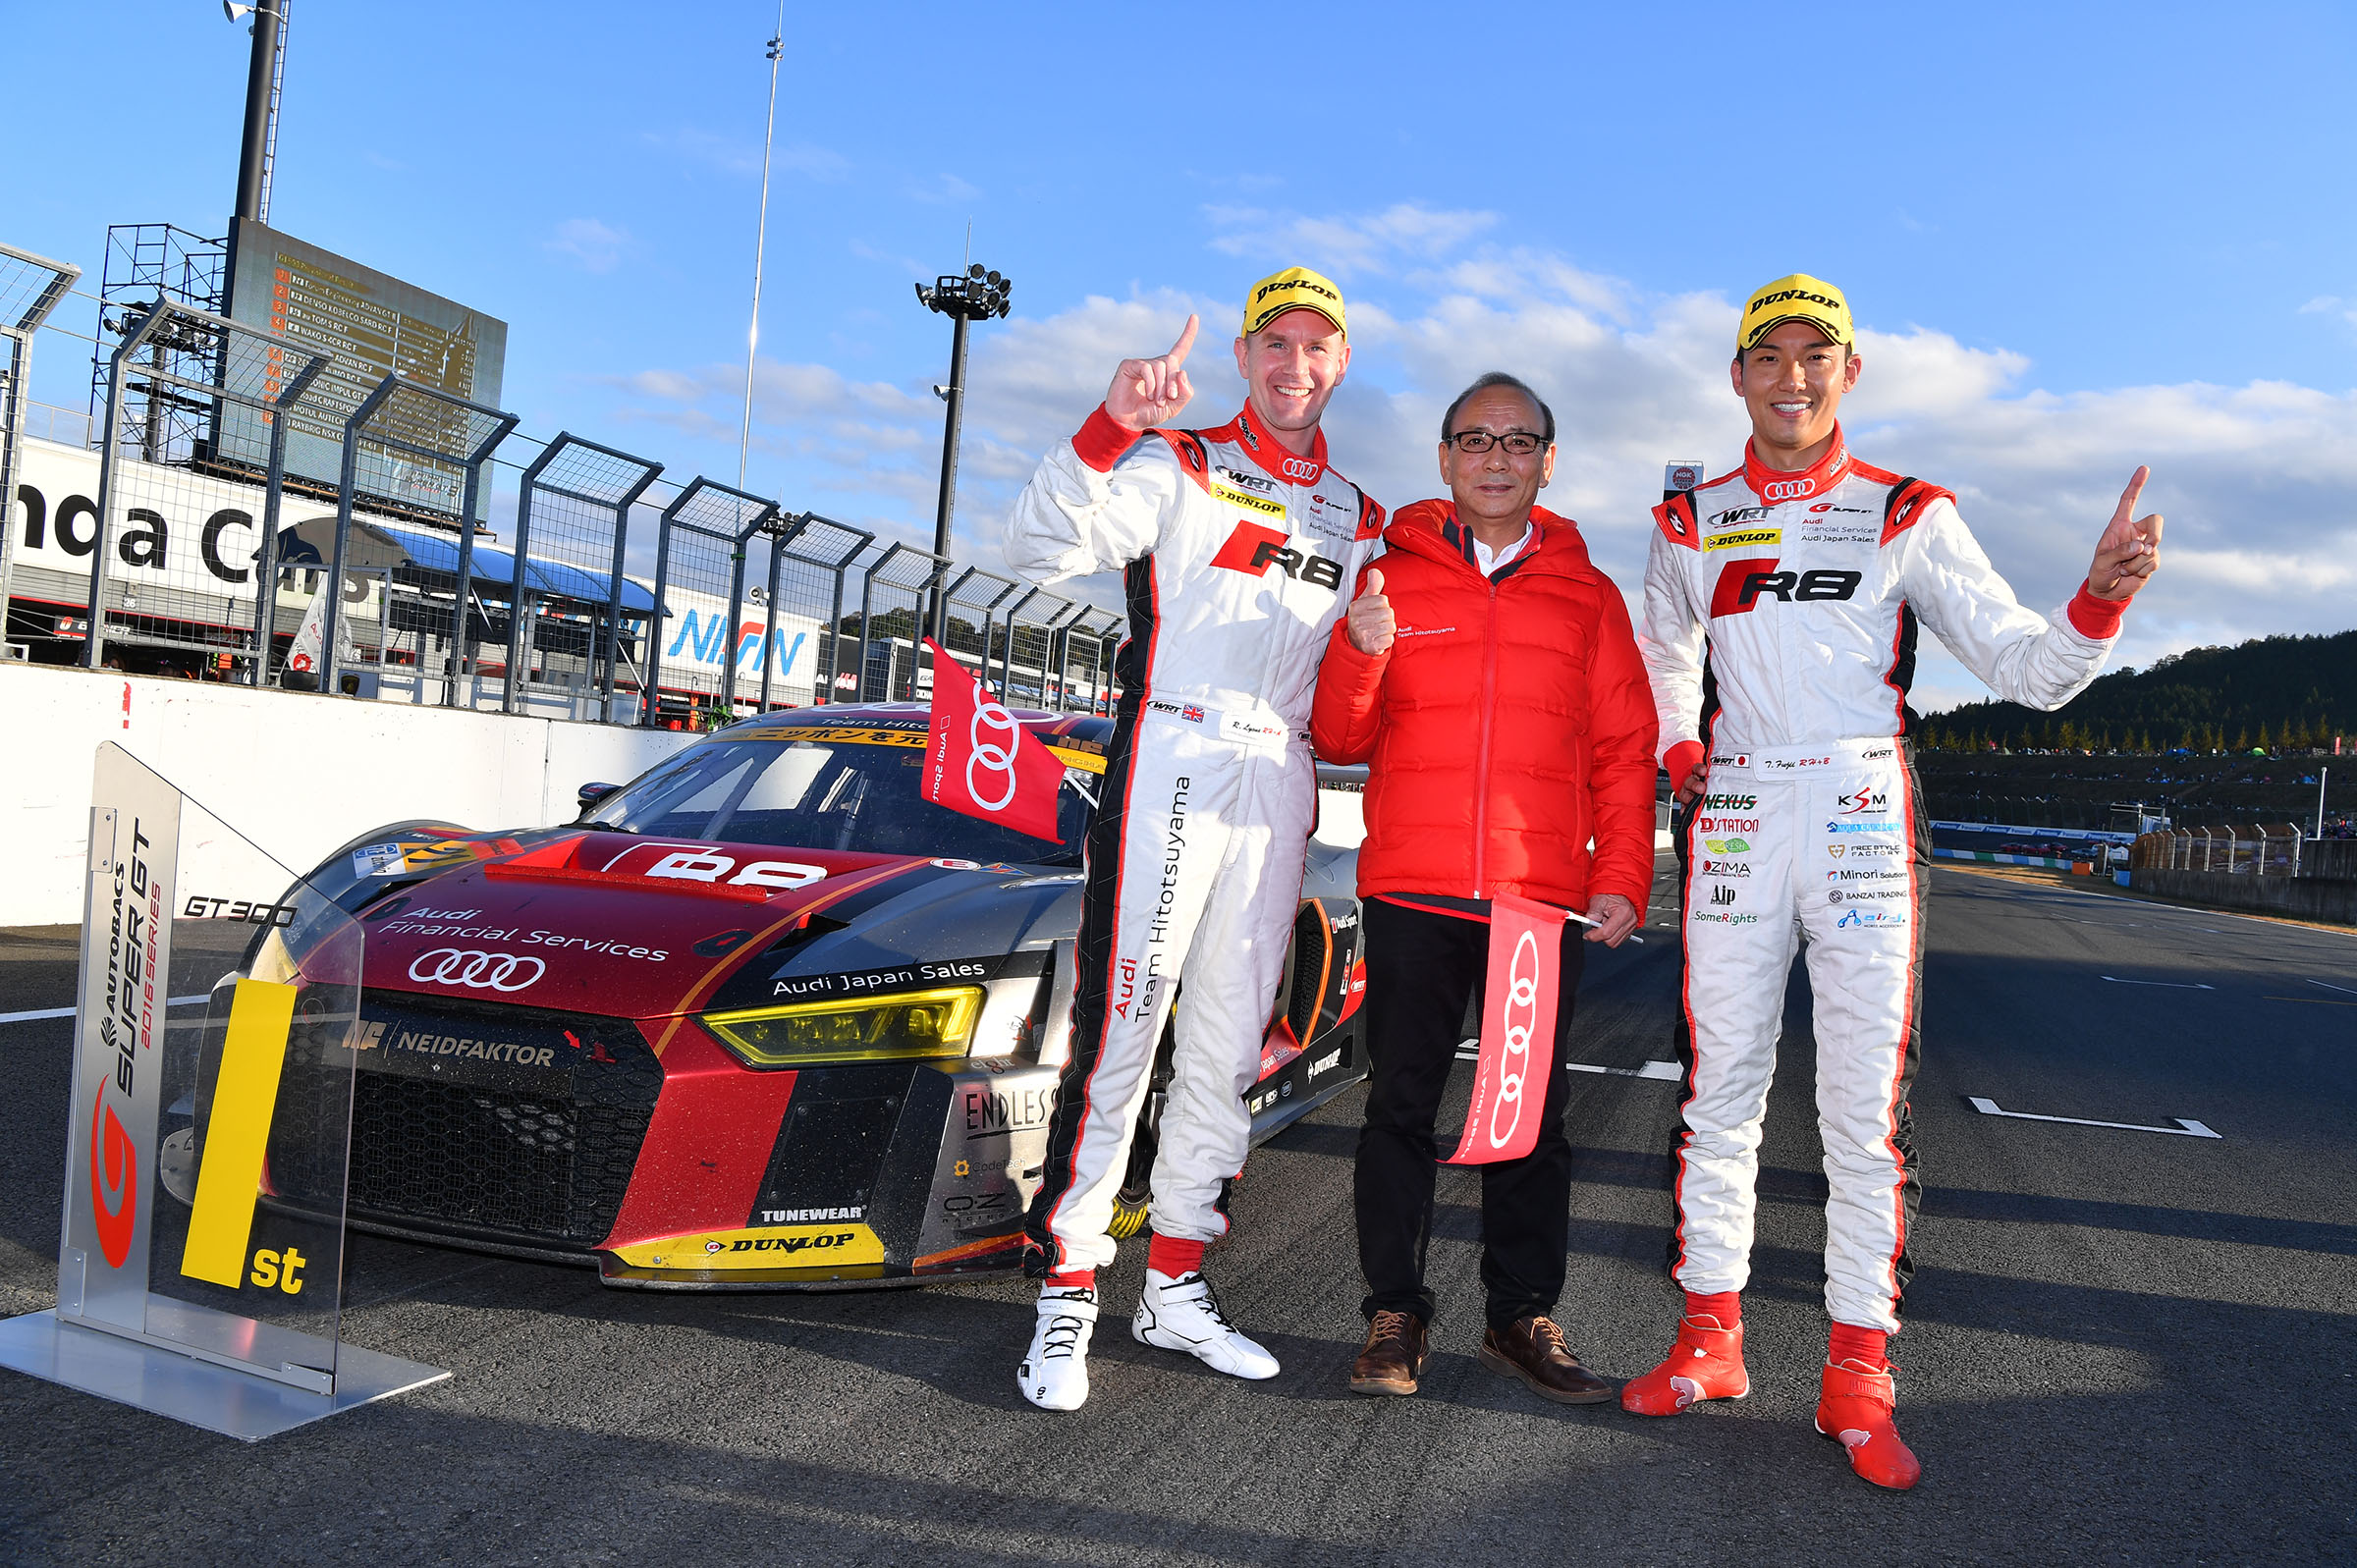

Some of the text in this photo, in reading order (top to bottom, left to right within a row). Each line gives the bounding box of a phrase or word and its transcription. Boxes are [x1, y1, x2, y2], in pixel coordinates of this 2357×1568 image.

[1256, 279, 1338, 304] DUNLOP
[1750, 290, 1839, 315] DUNLOP
[1227, 492, 1281, 514] DUNLOP
[1721, 508, 1775, 524] WRT
[1717, 533, 1776, 546] DUNLOP
[1249, 541, 1343, 591] R8
[1737, 569, 1862, 605] R8
[1704, 794, 1757, 810] NEXUS
[1840, 869, 1878, 881] Minori
[1135, 777, 1190, 1022] Team Hitotsuyama
[1711, 885, 1736, 905] Aip
[1878, 891, 1907, 899] TRADING
[401, 907, 483, 921] Audi
[1695, 911, 1758, 925] SomeRights
[106, 861, 125, 1015] AUTOBACS
[378, 921, 670, 962] Financial Services
[117, 817, 150, 1098] SUPER GT
[141, 881, 160, 1050] 2016 SERIES
[773, 962, 985, 996] Audi Japan Sales
[1115, 957, 1137, 1020] Audi
[397, 1031, 555, 1067] NEIDFAKTOR
[730, 1233, 855, 1254] DUNLOP
